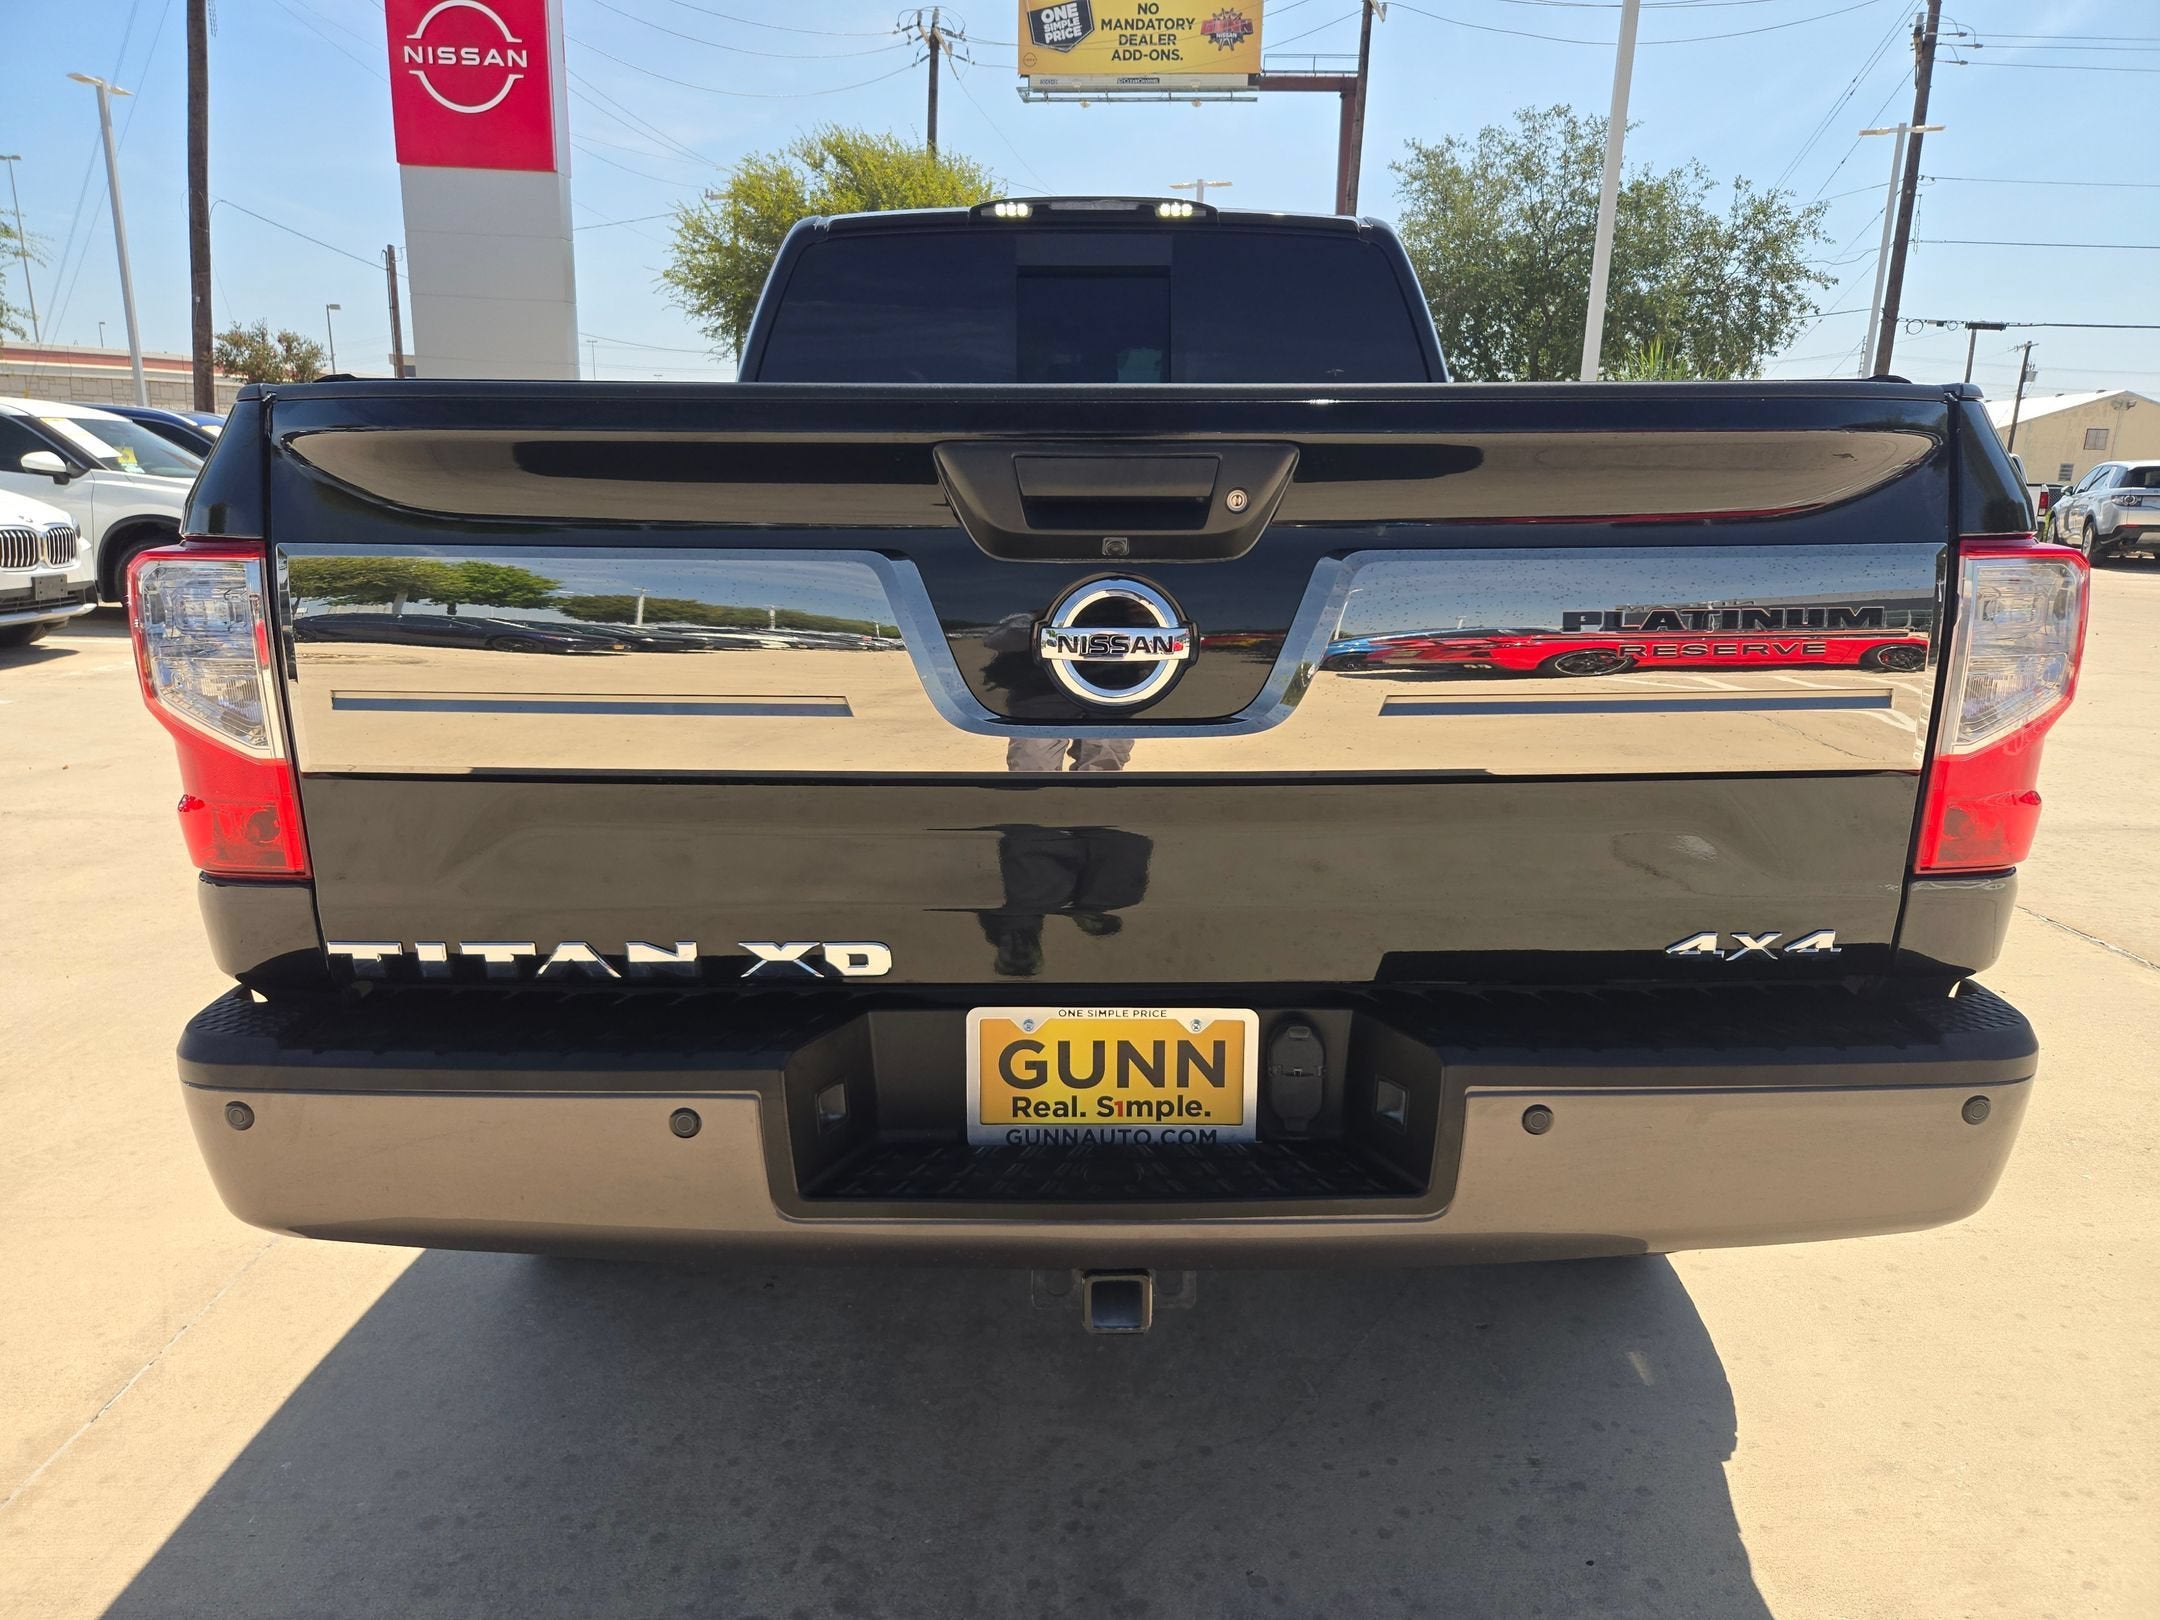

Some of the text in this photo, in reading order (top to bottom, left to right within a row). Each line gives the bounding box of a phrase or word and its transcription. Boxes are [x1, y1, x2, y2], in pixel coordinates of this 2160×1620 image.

[1041, 2, 1079, 24] ONE
[1137, 2, 1159, 15] NO
[1044, 16, 1081, 33] SIMPLE
[1101, 18, 1195, 31] MANDATORY
[1044, 25, 1083, 44] PRICE
[1118, 33, 1177, 46] DEALER
[403, 45, 528, 68] NISSAN
[1111, 49, 1184, 61] ADD-ONS.
[1562, 606, 1885, 632] PLATINUM
[1057, 634, 1175, 655] NISSAN
[1616, 641, 1828, 658] RESERVE
[327, 941, 894, 978] TITAN XD
[1058, 1009, 1168, 1019] ONE SIMPLE PRICE
[998, 1039, 1226, 1090] GUNN
[1011, 1096, 1087, 1118] Real.
[1005, 1129, 1218, 1146] GUNNAUTO.COM
